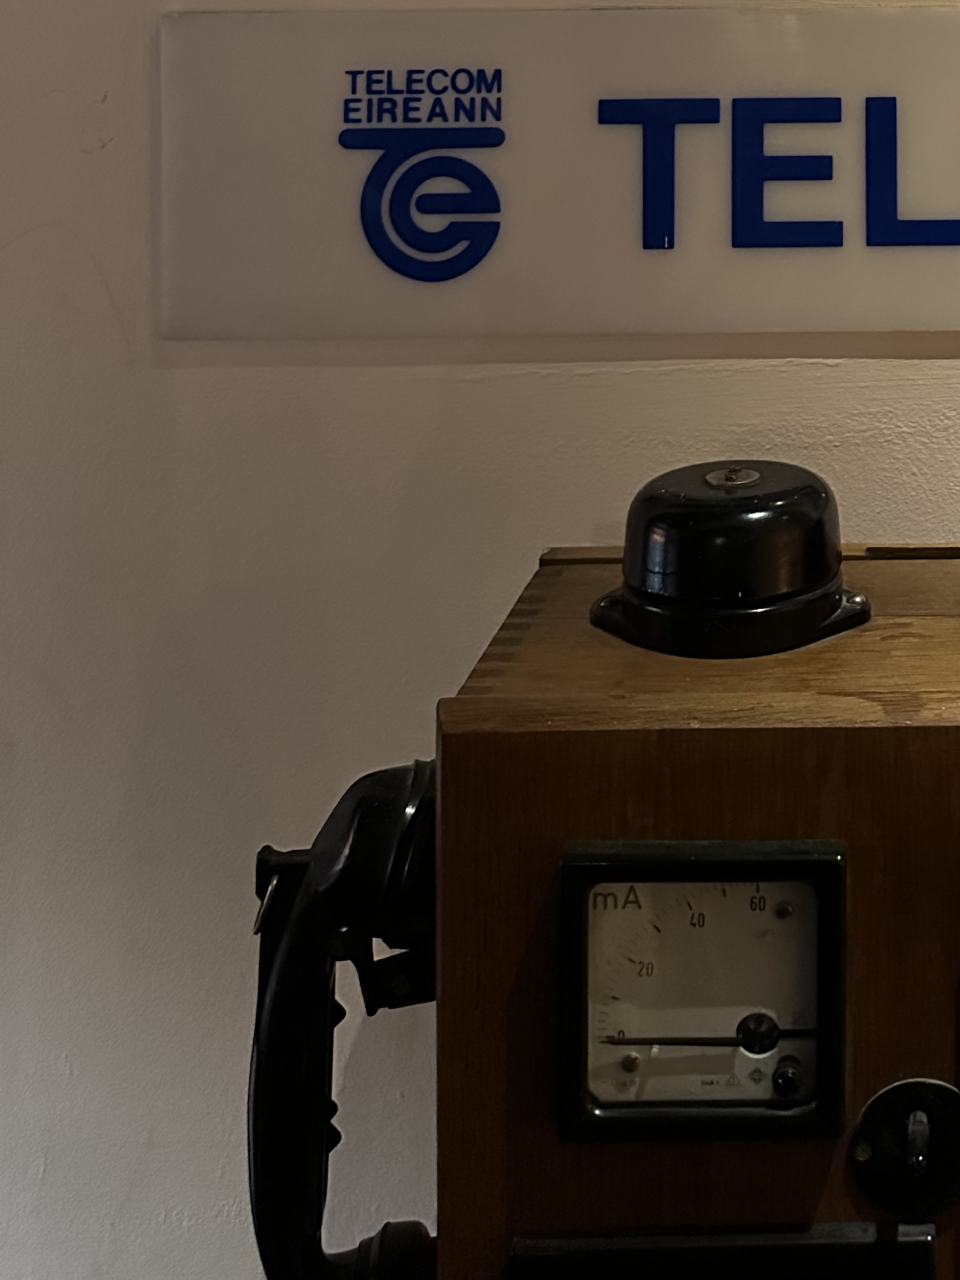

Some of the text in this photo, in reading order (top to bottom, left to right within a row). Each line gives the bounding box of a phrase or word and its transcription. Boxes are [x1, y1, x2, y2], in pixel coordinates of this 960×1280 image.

[344, 68, 503, 96] TELECOM
[342, 96, 503, 124] EIREANN
[592, 884, 643, 911] mA
[749, 895, 767, 912] 60
[689, 912, 706, 929] 40
[637, 960, 655, 978] 20
